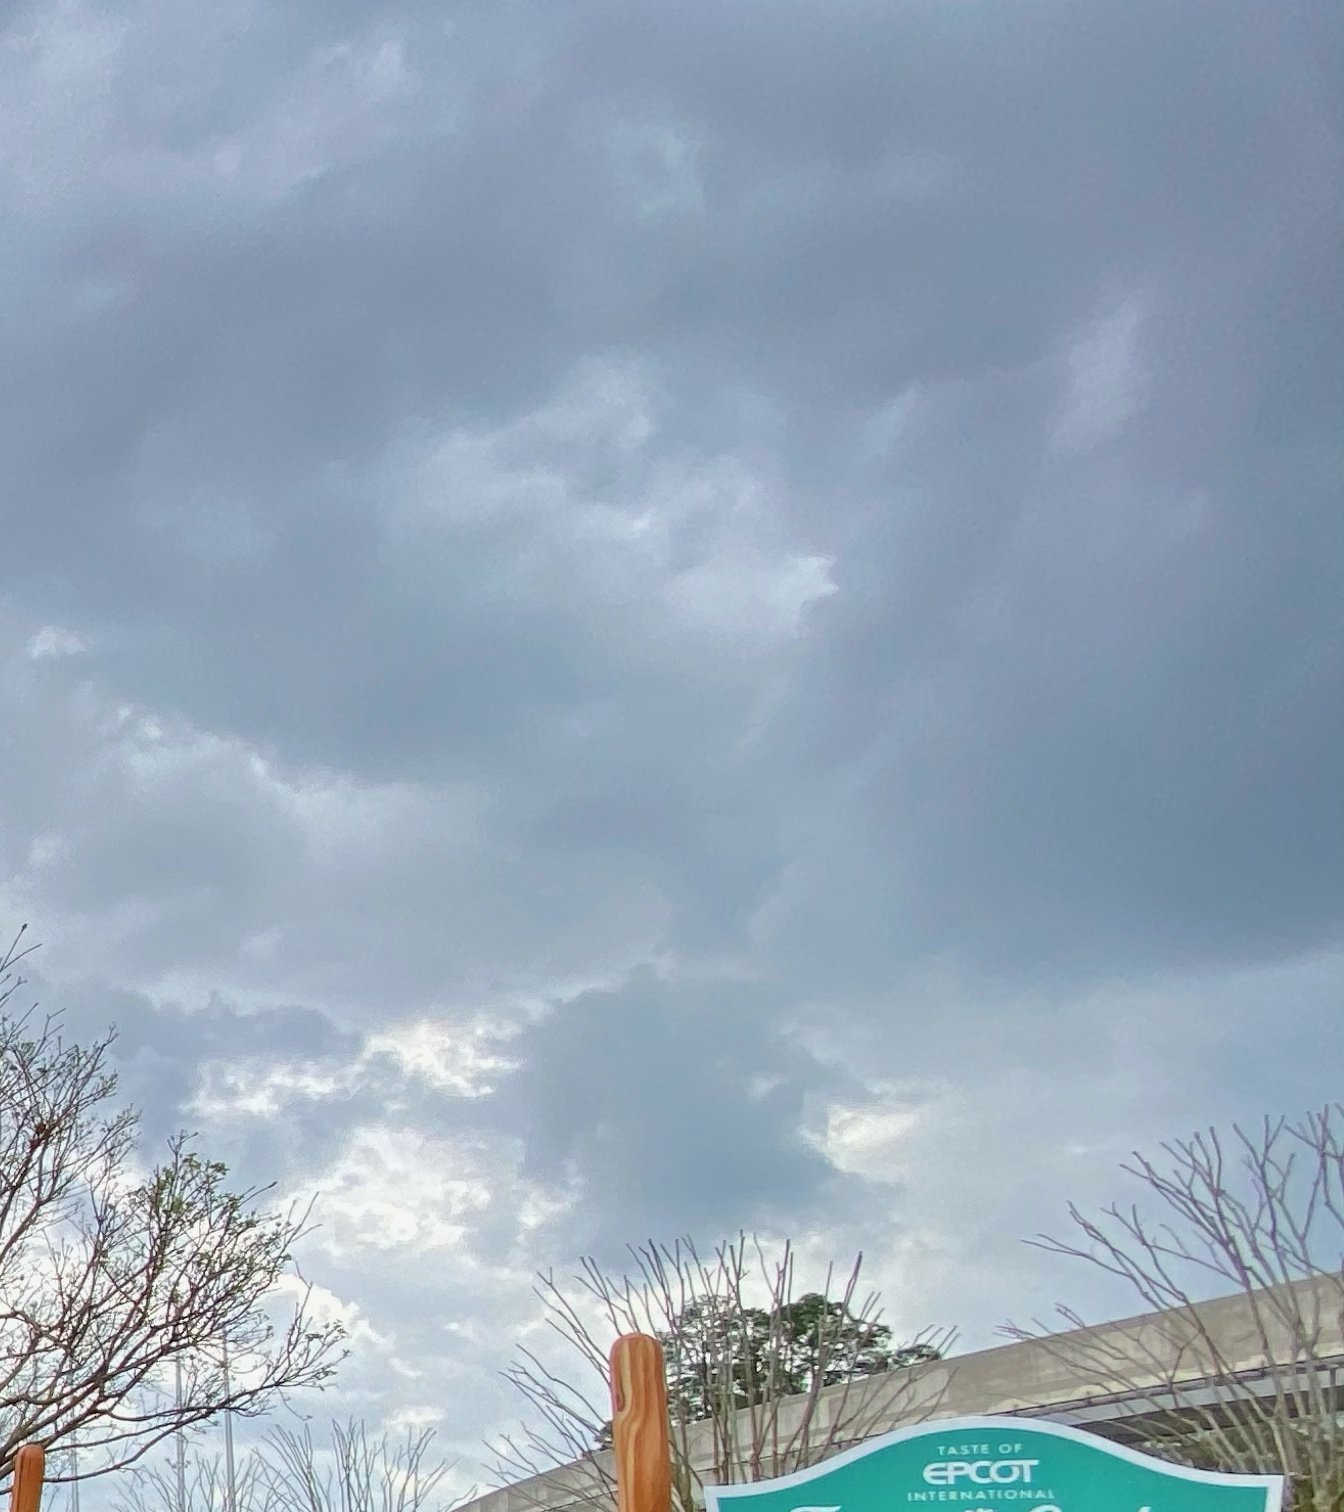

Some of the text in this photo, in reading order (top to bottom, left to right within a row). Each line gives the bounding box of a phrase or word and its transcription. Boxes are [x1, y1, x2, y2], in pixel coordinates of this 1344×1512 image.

[937, 1442, 1022, 1456] TASTE OF
[922, 1459, 1040, 1485] EPCOT
[907, 1489, 1056, 1502] INTERNATIONAL
